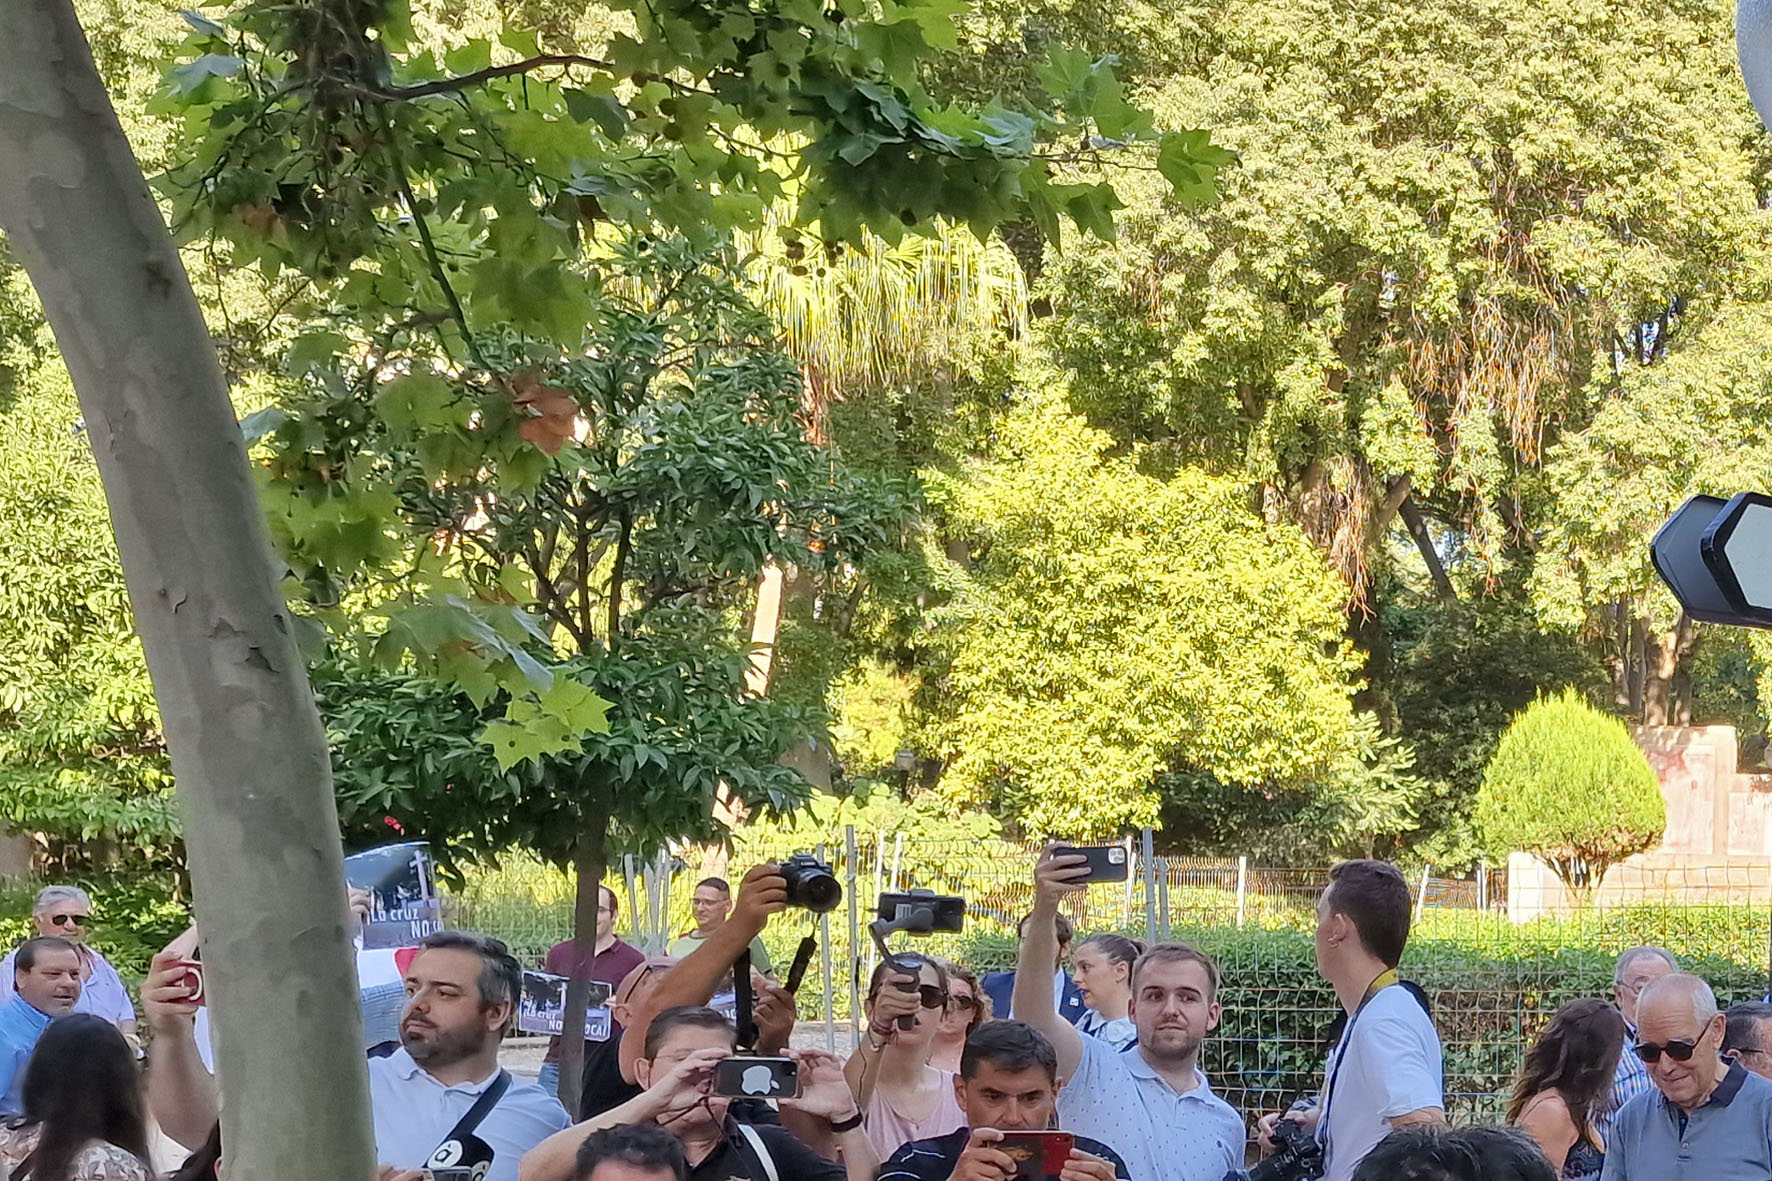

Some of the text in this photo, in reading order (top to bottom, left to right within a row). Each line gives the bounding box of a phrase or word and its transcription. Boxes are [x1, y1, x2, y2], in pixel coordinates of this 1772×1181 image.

[389, 907, 420, 922] cruz
[410, 920, 430, 939] NO
[548, 1020, 563, 1031] NO
